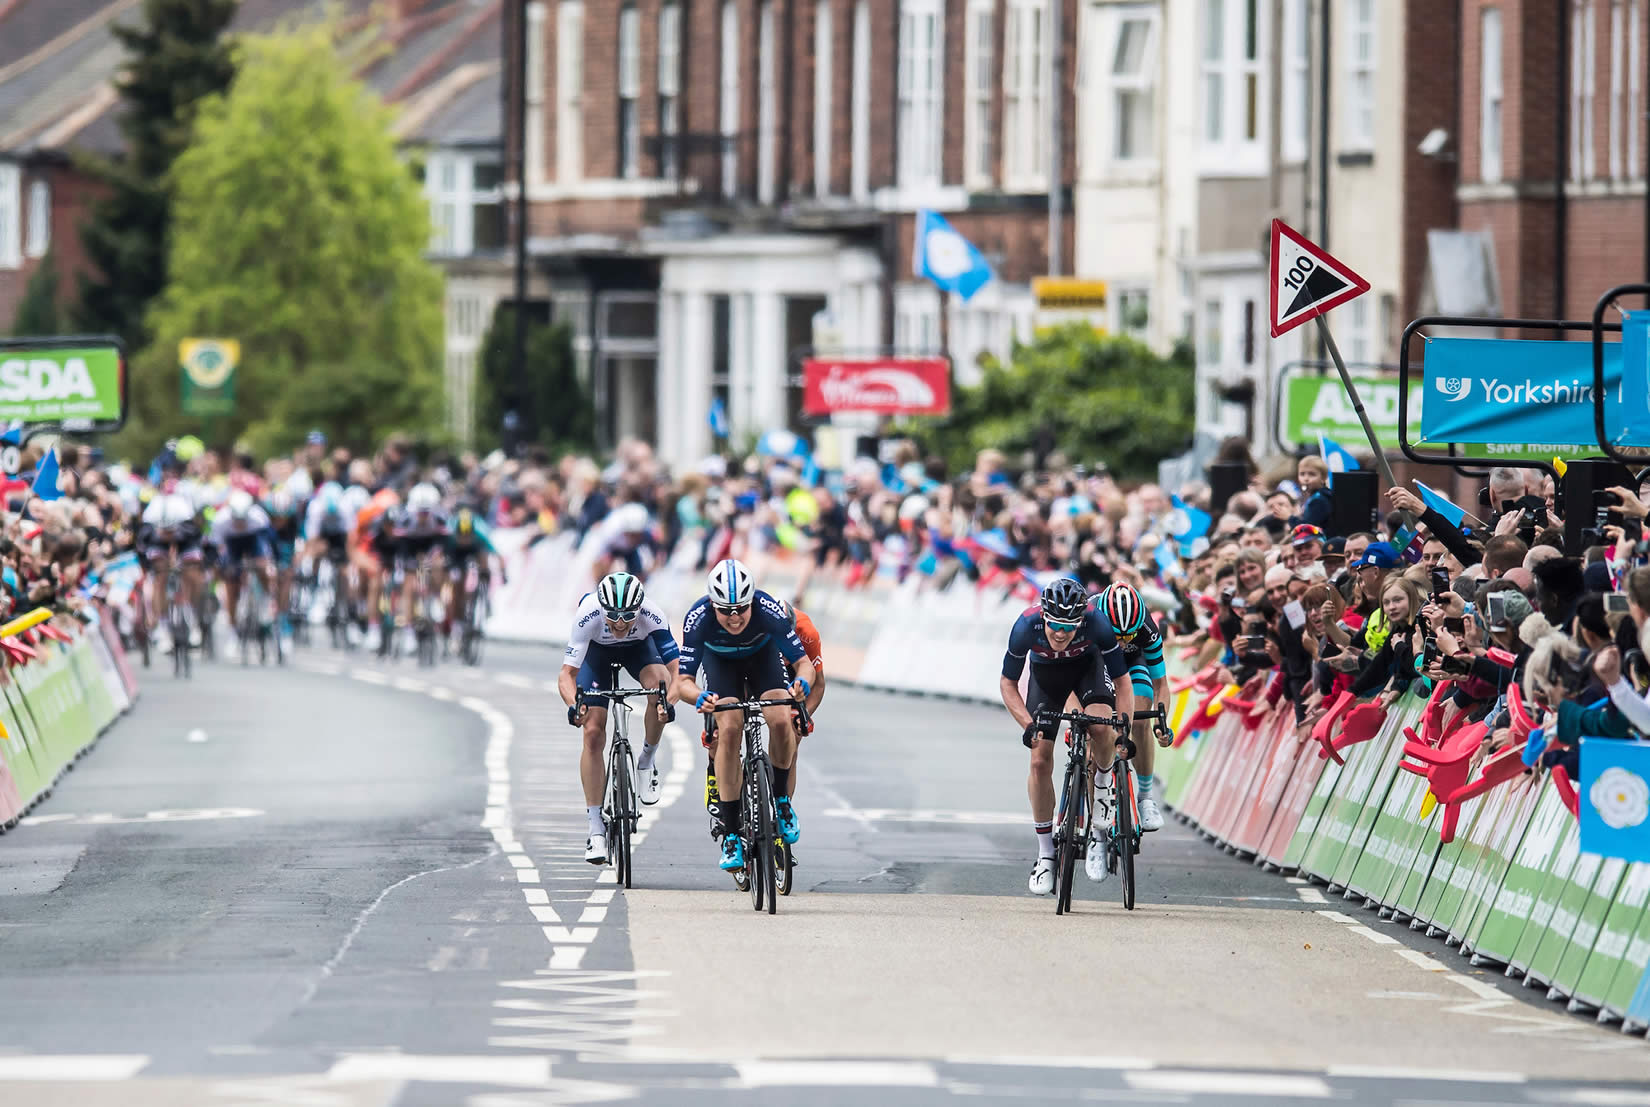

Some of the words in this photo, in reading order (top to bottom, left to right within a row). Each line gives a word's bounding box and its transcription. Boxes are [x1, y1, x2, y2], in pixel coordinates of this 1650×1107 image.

[1283, 255, 1314, 291] 100
[1479, 379, 1607, 404] Yorkshire
[1487, 443, 1526, 454] Save
[684, 604, 706, 633] brother
[760, 597, 787, 619] brother
